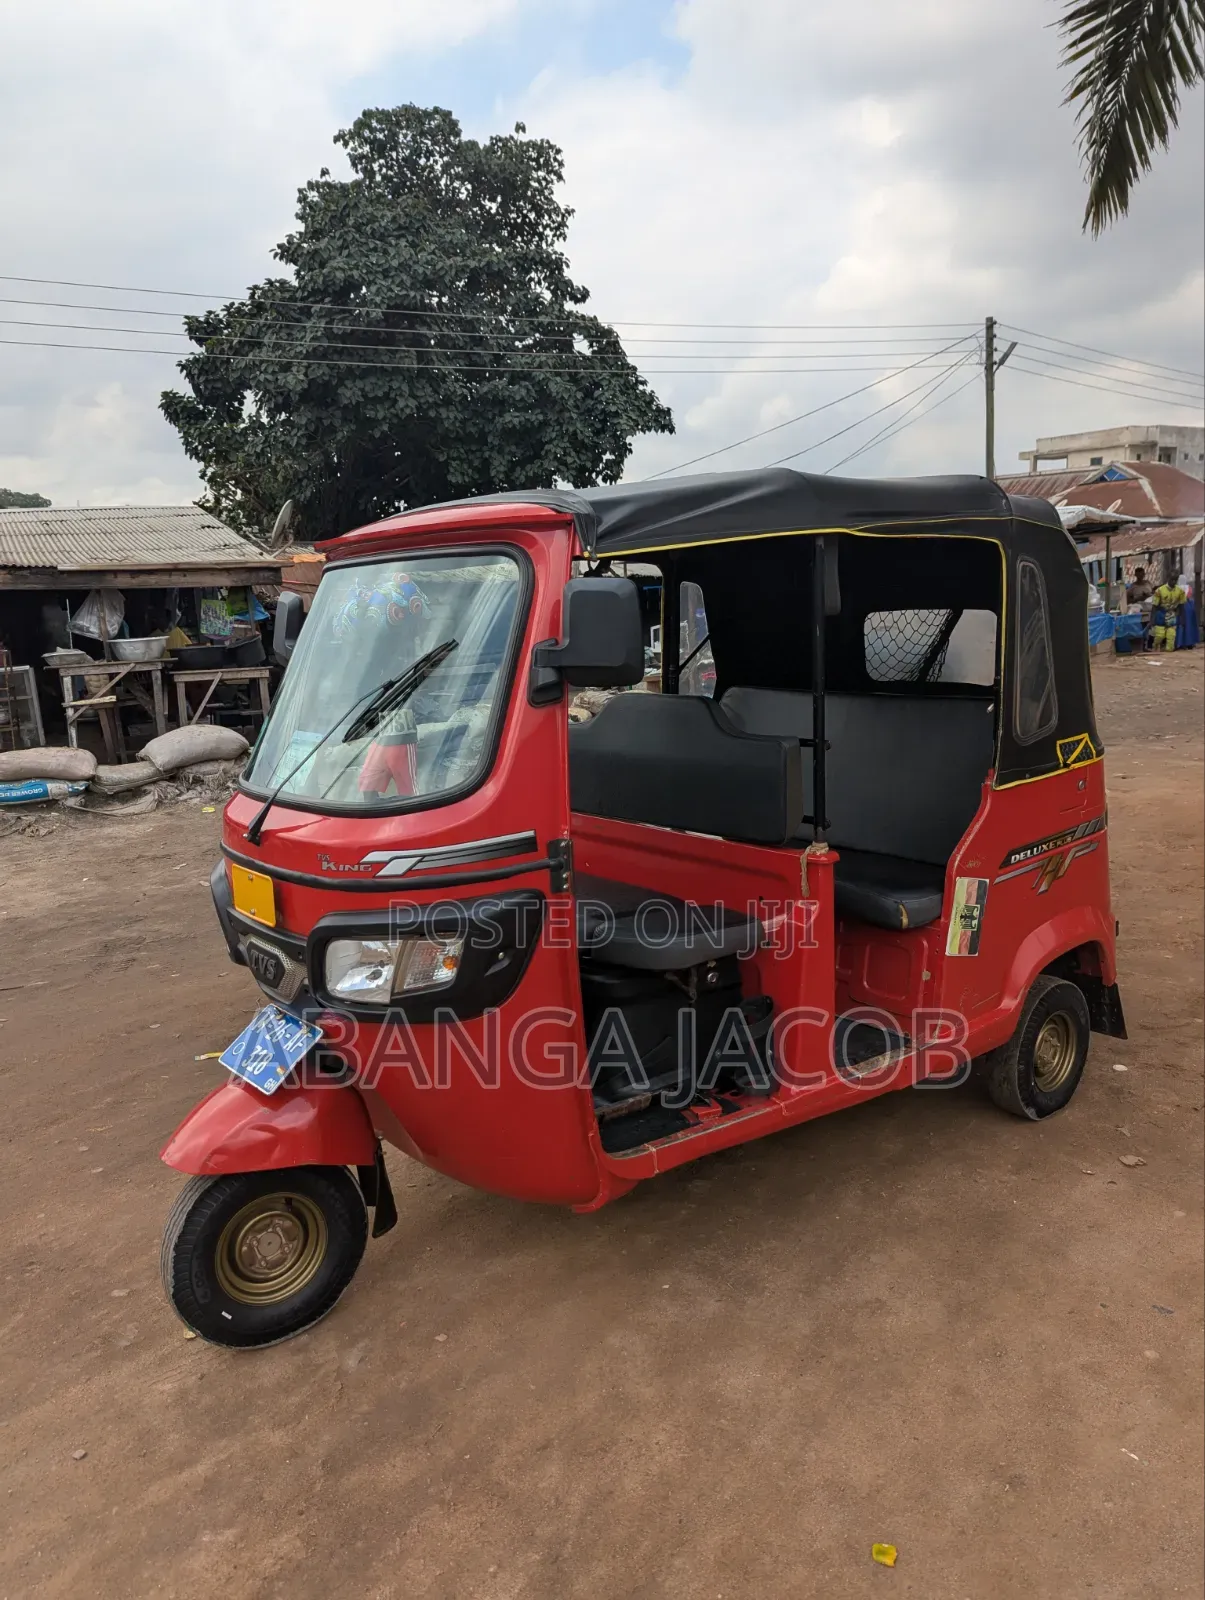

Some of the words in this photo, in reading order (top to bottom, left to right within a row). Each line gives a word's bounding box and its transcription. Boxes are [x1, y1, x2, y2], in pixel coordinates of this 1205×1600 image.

[11, 787, 43, 797] GROWER
[317, 853, 330, 861] TVS
[1010, 841, 1057, 865] DELUXE
[1056, 836, 1073, 848] PLUS
[322, 861, 372, 872] KING
[251, 948, 277, 981] TVS
[241, 1045, 274, 1076] 318
[264, 1077, 278, 1091] GH
